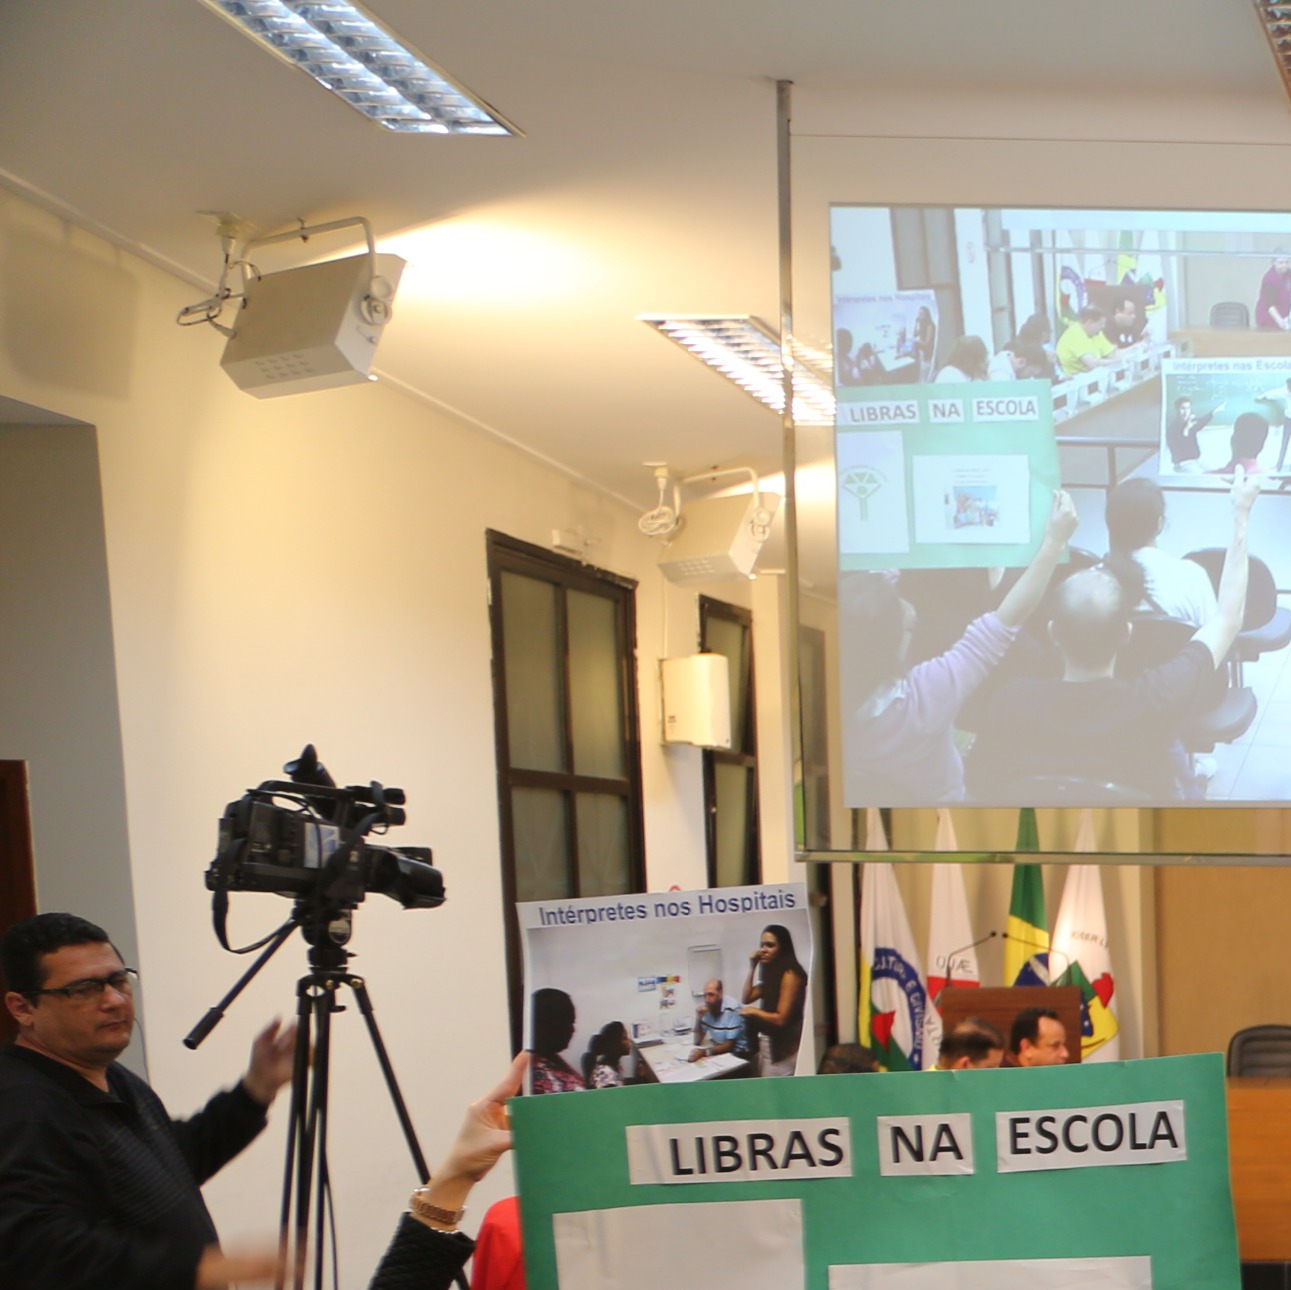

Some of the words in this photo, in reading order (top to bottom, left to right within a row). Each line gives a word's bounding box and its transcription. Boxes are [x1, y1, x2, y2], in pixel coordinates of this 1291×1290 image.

[849, 403, 917, 423] LIBRAS
[932, 402, 961, 418] NA
[975, 399, 1037, 416] ESCOLA
[539, 902, 648, 926] Intérpretes
[654, 899, 691, 918] nos
[698, 889, 796, 914] Hospitais
[669, 1128, 845, 1177] LIBRAS
[890, 1122, 964, 1165] NA
[1008, 1111, 1178, 1156] ESCOLA
